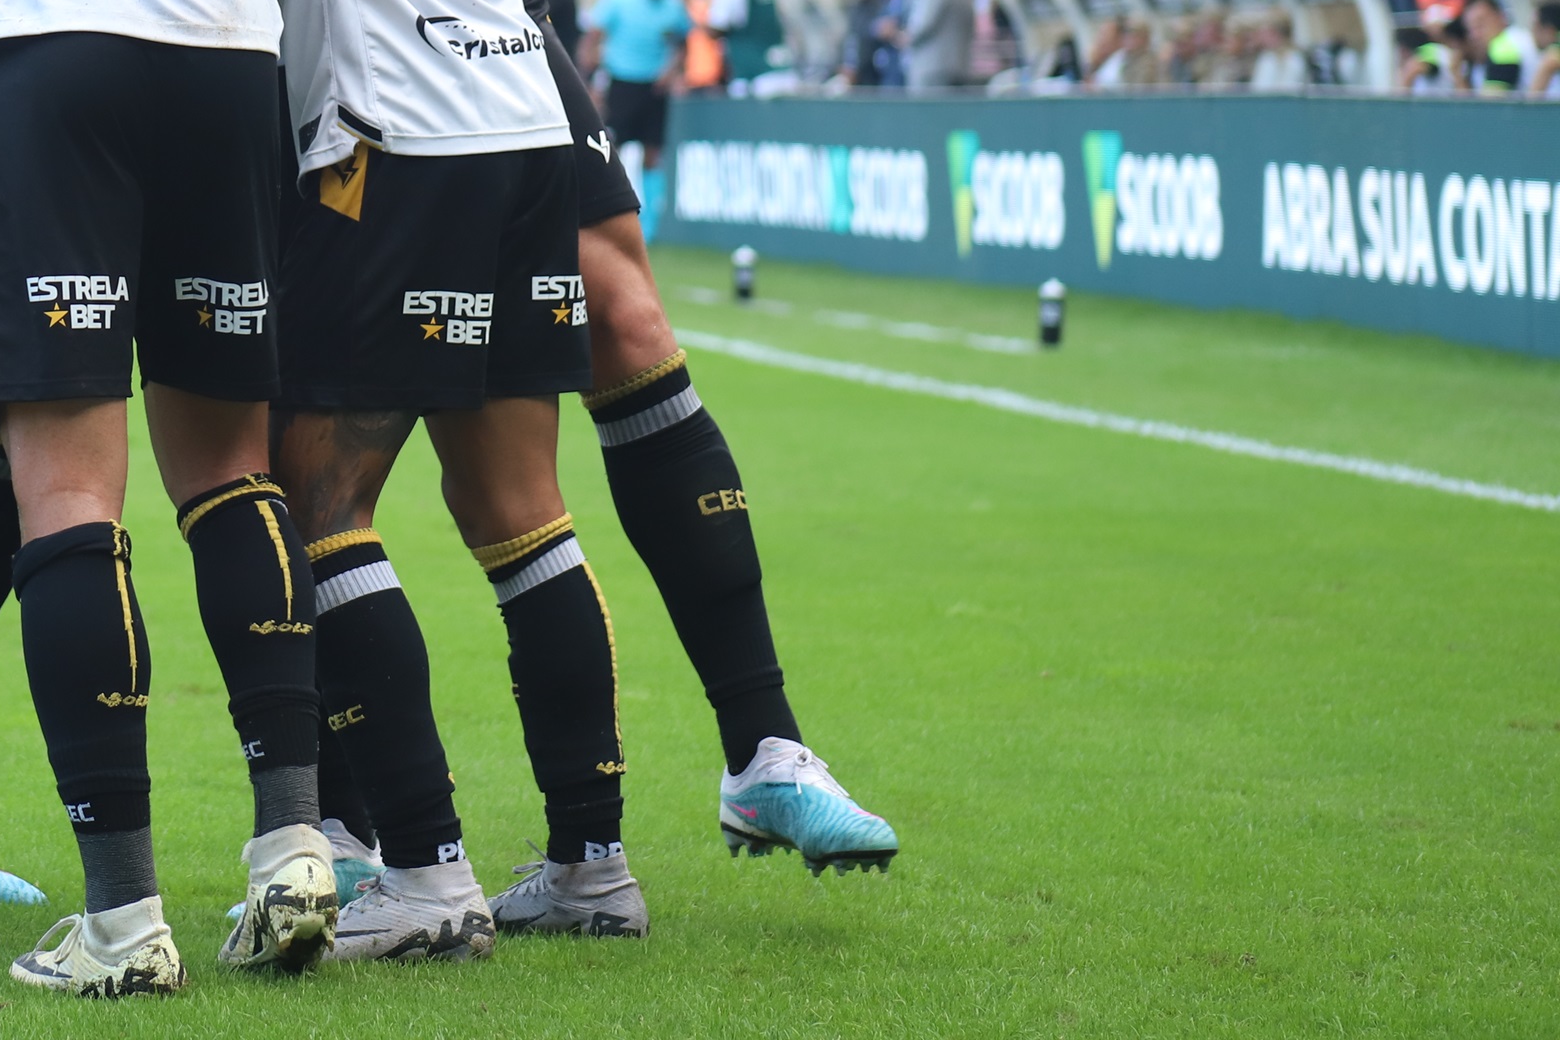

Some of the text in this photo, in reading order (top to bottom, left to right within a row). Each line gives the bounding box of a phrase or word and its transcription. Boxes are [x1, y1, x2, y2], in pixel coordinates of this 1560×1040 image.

[971, 150, 1065, 250] SICOOB
[1115, 151, 1223, 261] SICOOB
[1261, 160, 1360, 278] ABRA
[1359, 165, 1438, 288] SUA
[26, 274, 130, 302] ESTRELA
[70, 304, 116, 330] BET
[214, 308, 267, 335] BET
